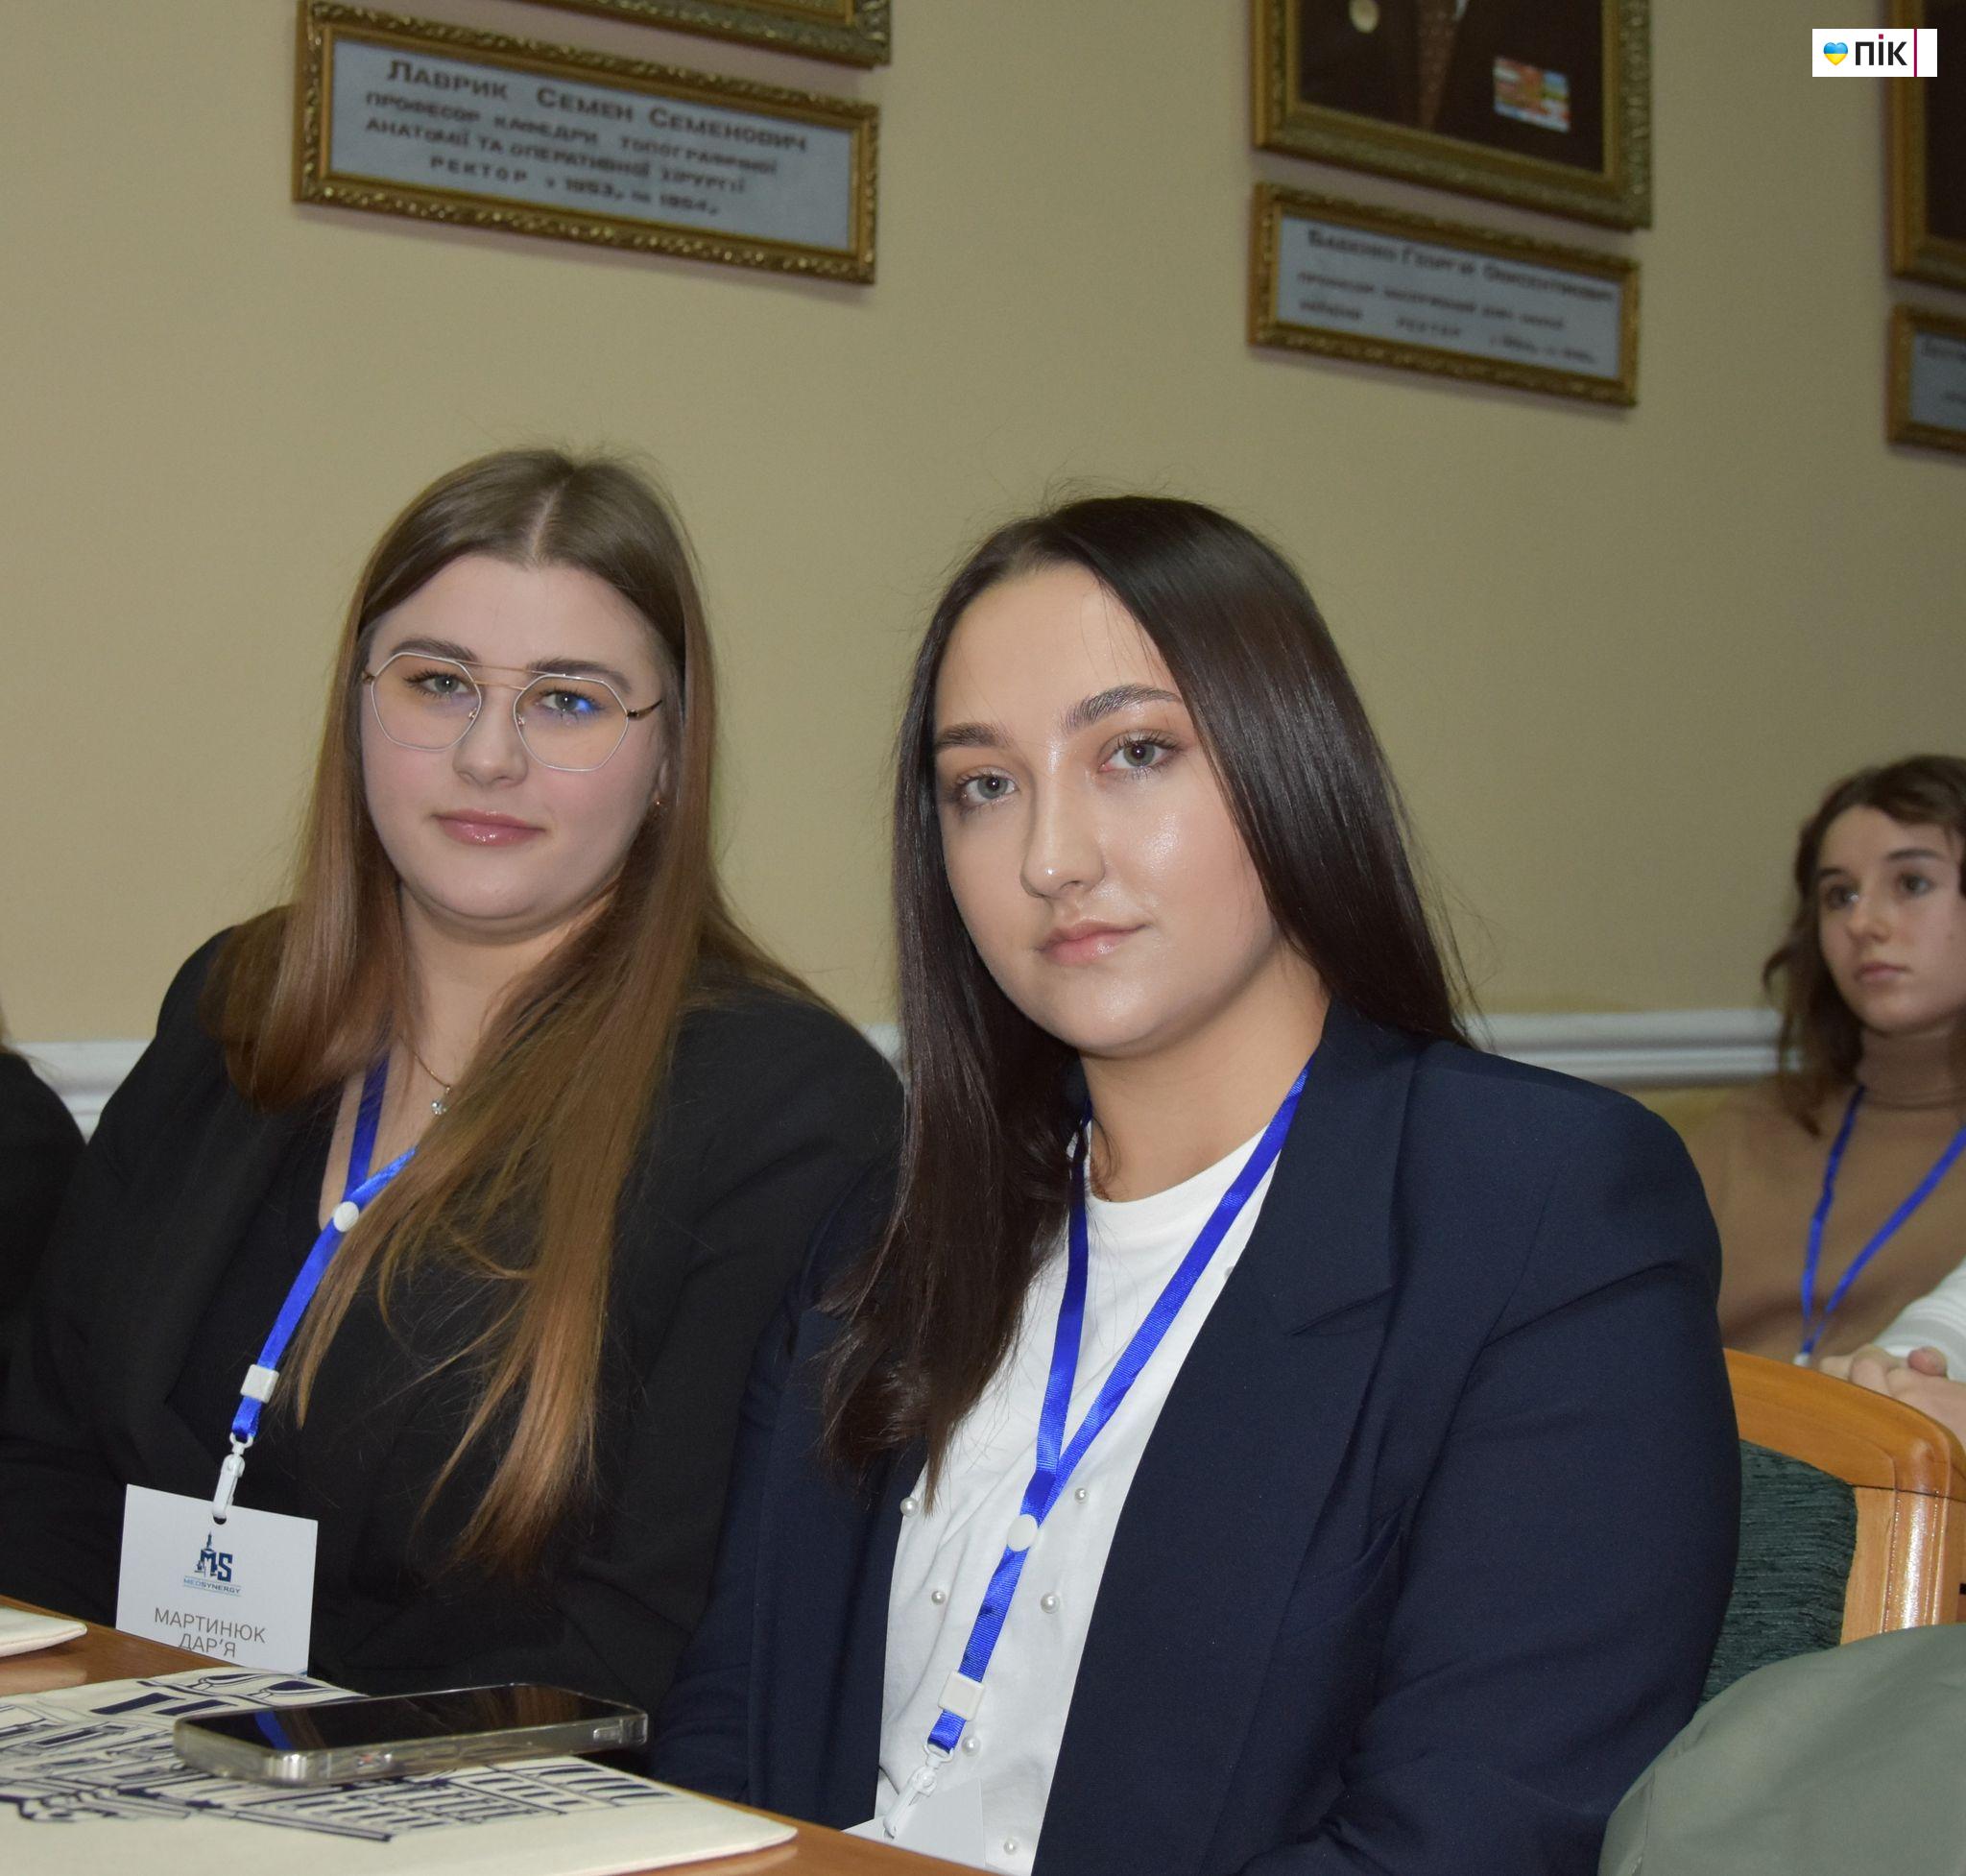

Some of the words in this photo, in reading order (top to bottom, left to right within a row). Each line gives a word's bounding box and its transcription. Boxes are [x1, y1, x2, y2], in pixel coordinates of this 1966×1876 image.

[387, 59, 509, 100] ЛАВРИК
[536, 86, 634, 122] СЕМЕН
[478, 135, 504, 155] ТА
[429, 155, 529, 183] РЕКТОР
[183, 1577, 241, 1595] MEDSYNERGY
[154, 1607, 266, 1645] МАРТИНЮК
